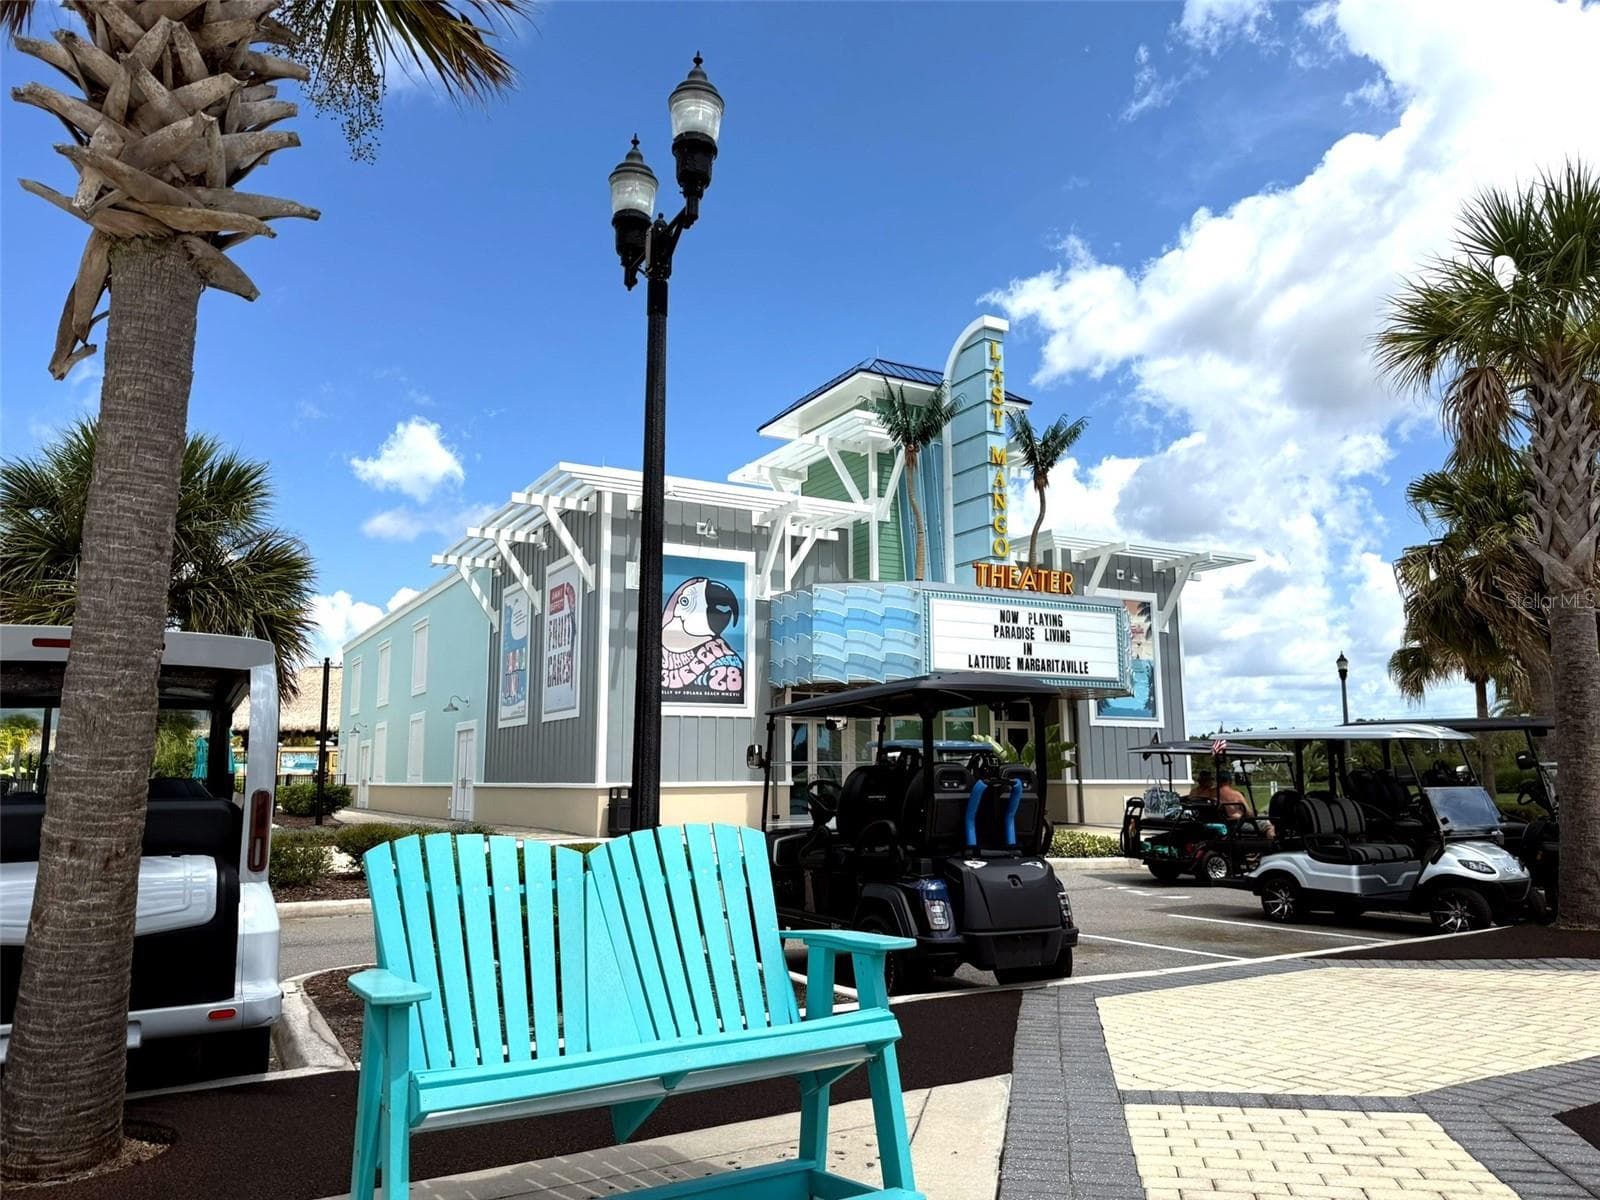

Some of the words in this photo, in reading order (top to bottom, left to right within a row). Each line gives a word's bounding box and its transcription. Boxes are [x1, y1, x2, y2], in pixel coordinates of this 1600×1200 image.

[990, 341, 1005, 428] LAST
[991, 446, 1010, 558] MANGO
[972, 562, 1075, 595] THEATER
[999, 609, 1019, 625] NOW
[1028, 612, 1064, 627] PLAYING
[993, 625, 1036, 641] PARADISE
[1044, 628, 1071, 643] LIVING
[661, 648, 695, 670] JIMMY
[1023, 642, 1033, 656] IN
[968, 654, 1011, 670] LATITUDE
[1017, 657, 1089, 674] MARGARITAVILLE
[709, 666, 742, 691] 28
